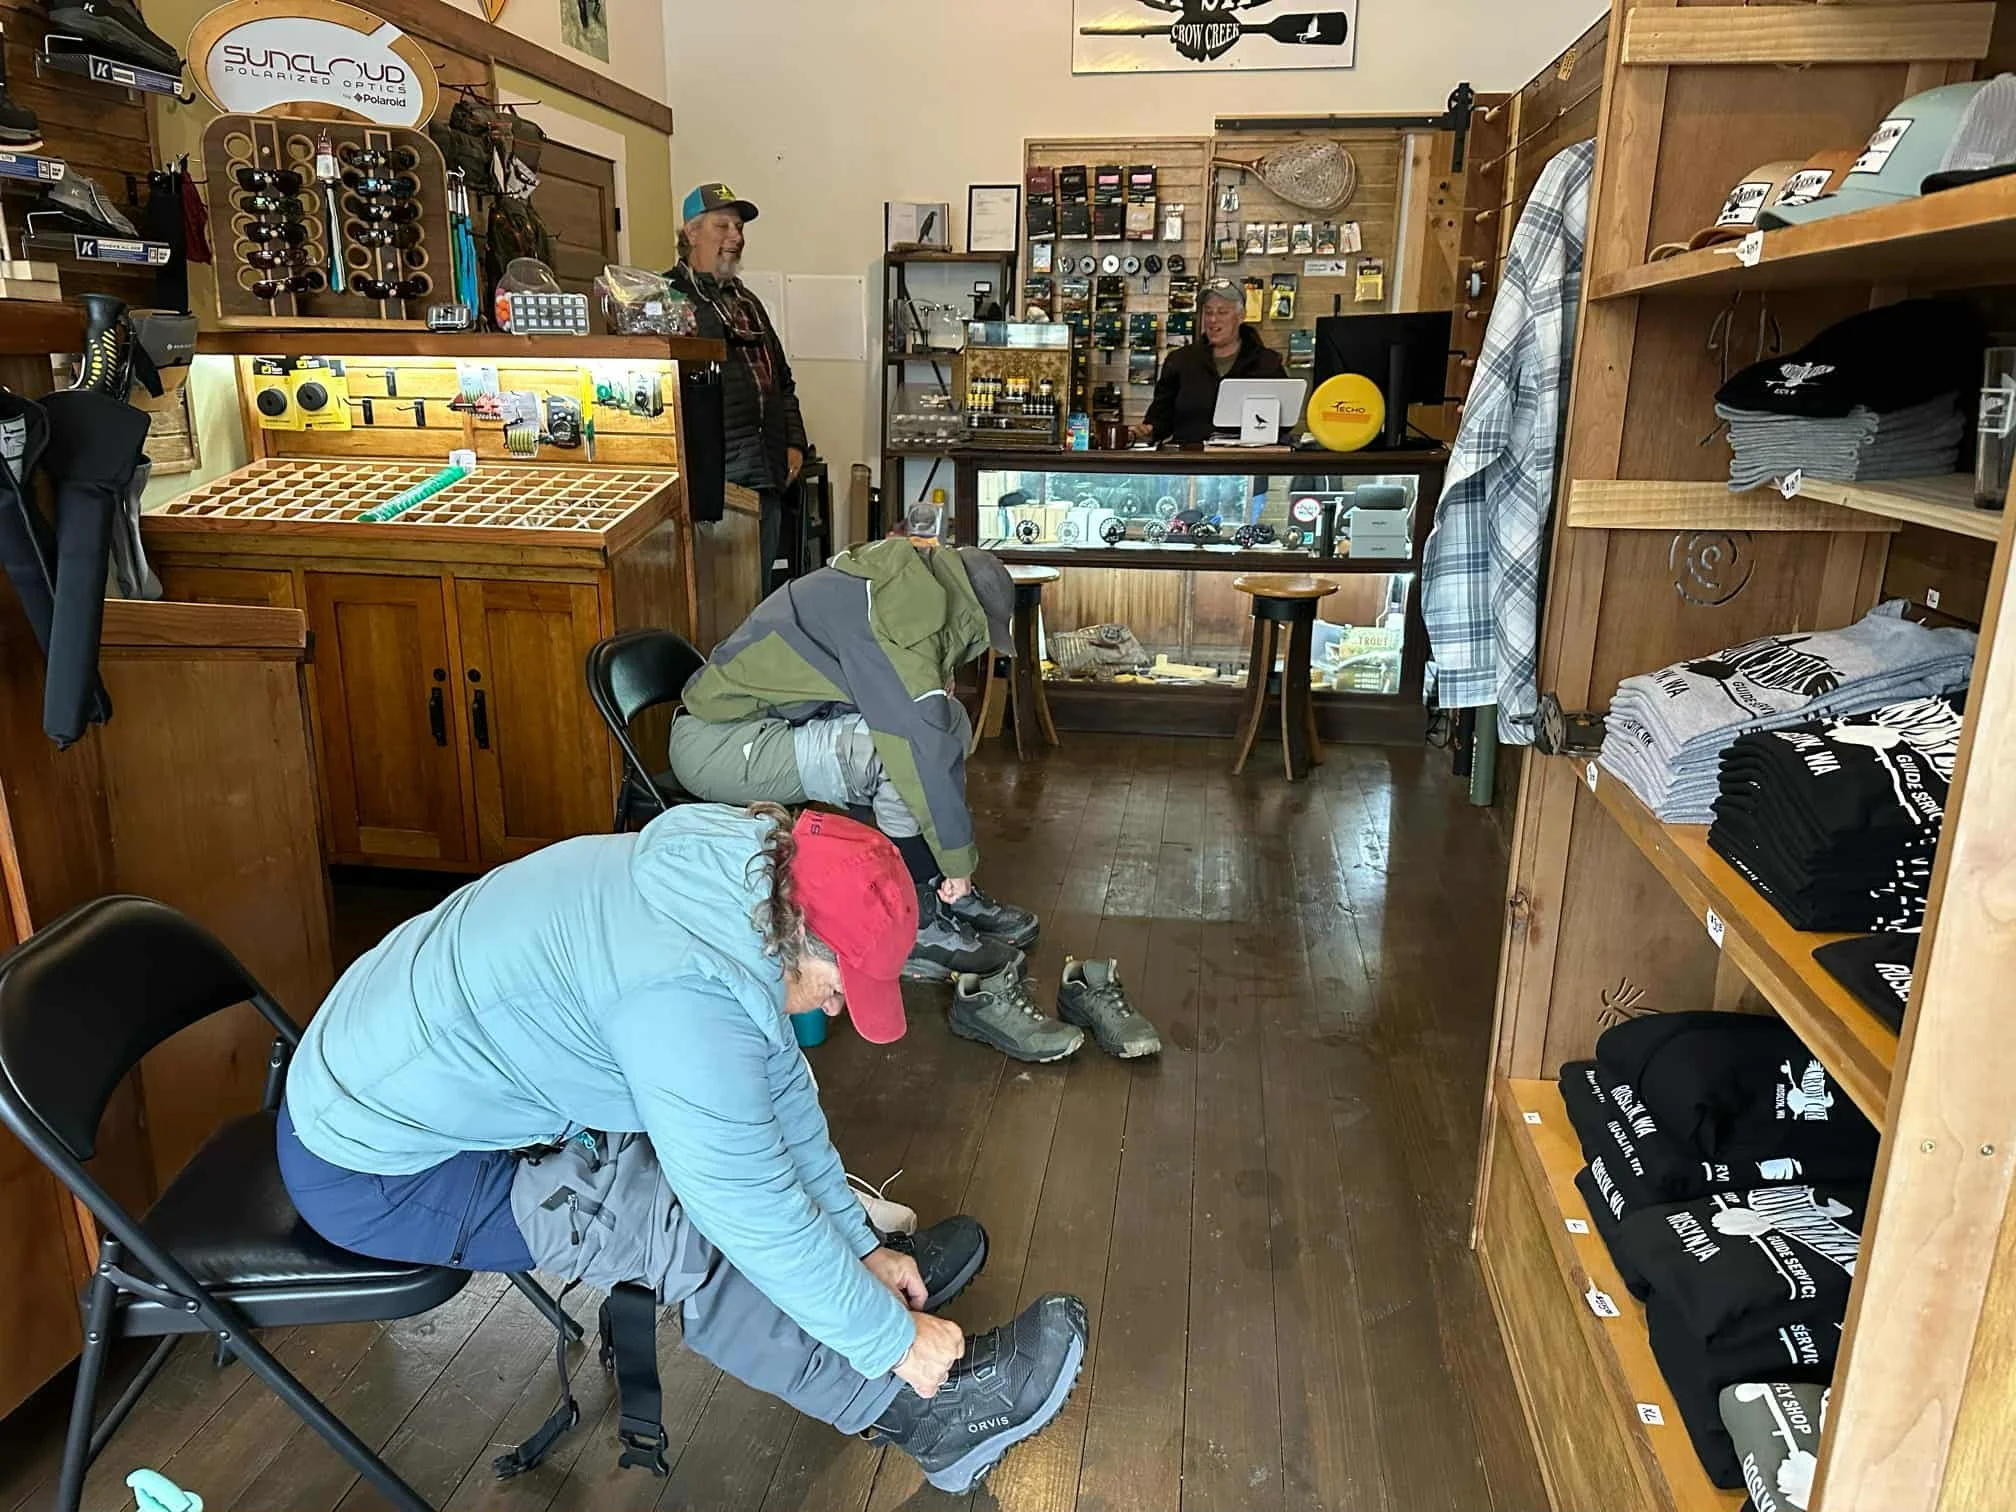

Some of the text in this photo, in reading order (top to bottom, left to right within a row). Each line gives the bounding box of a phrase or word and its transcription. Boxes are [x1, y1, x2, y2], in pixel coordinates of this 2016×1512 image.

[1171, 23, 1240, 51] CROW CREEK
[223, 45, 406, 84] SUNCLOUD
[224, 65, 407, 94] POLARIZED OPTICS
[363, 94, 406, 107] Polaroid
[1804, 750, 1841, 776] WA
[1896, 754, 1924, 790] GUIDE
[1911, 789, 1944, 822] SERVIC
[1874, 963, 1912, 1002] ROSL
[1632, 1116, 1657, 1139] WA
[1766, 1235, 1794, 1259] GUIDE
[1790, 1322, 1820, 1365] SERVIC
[968, 1416, 1009, 1433] ORVIS
[1782, 1400, 1812, 1435] SHOP
